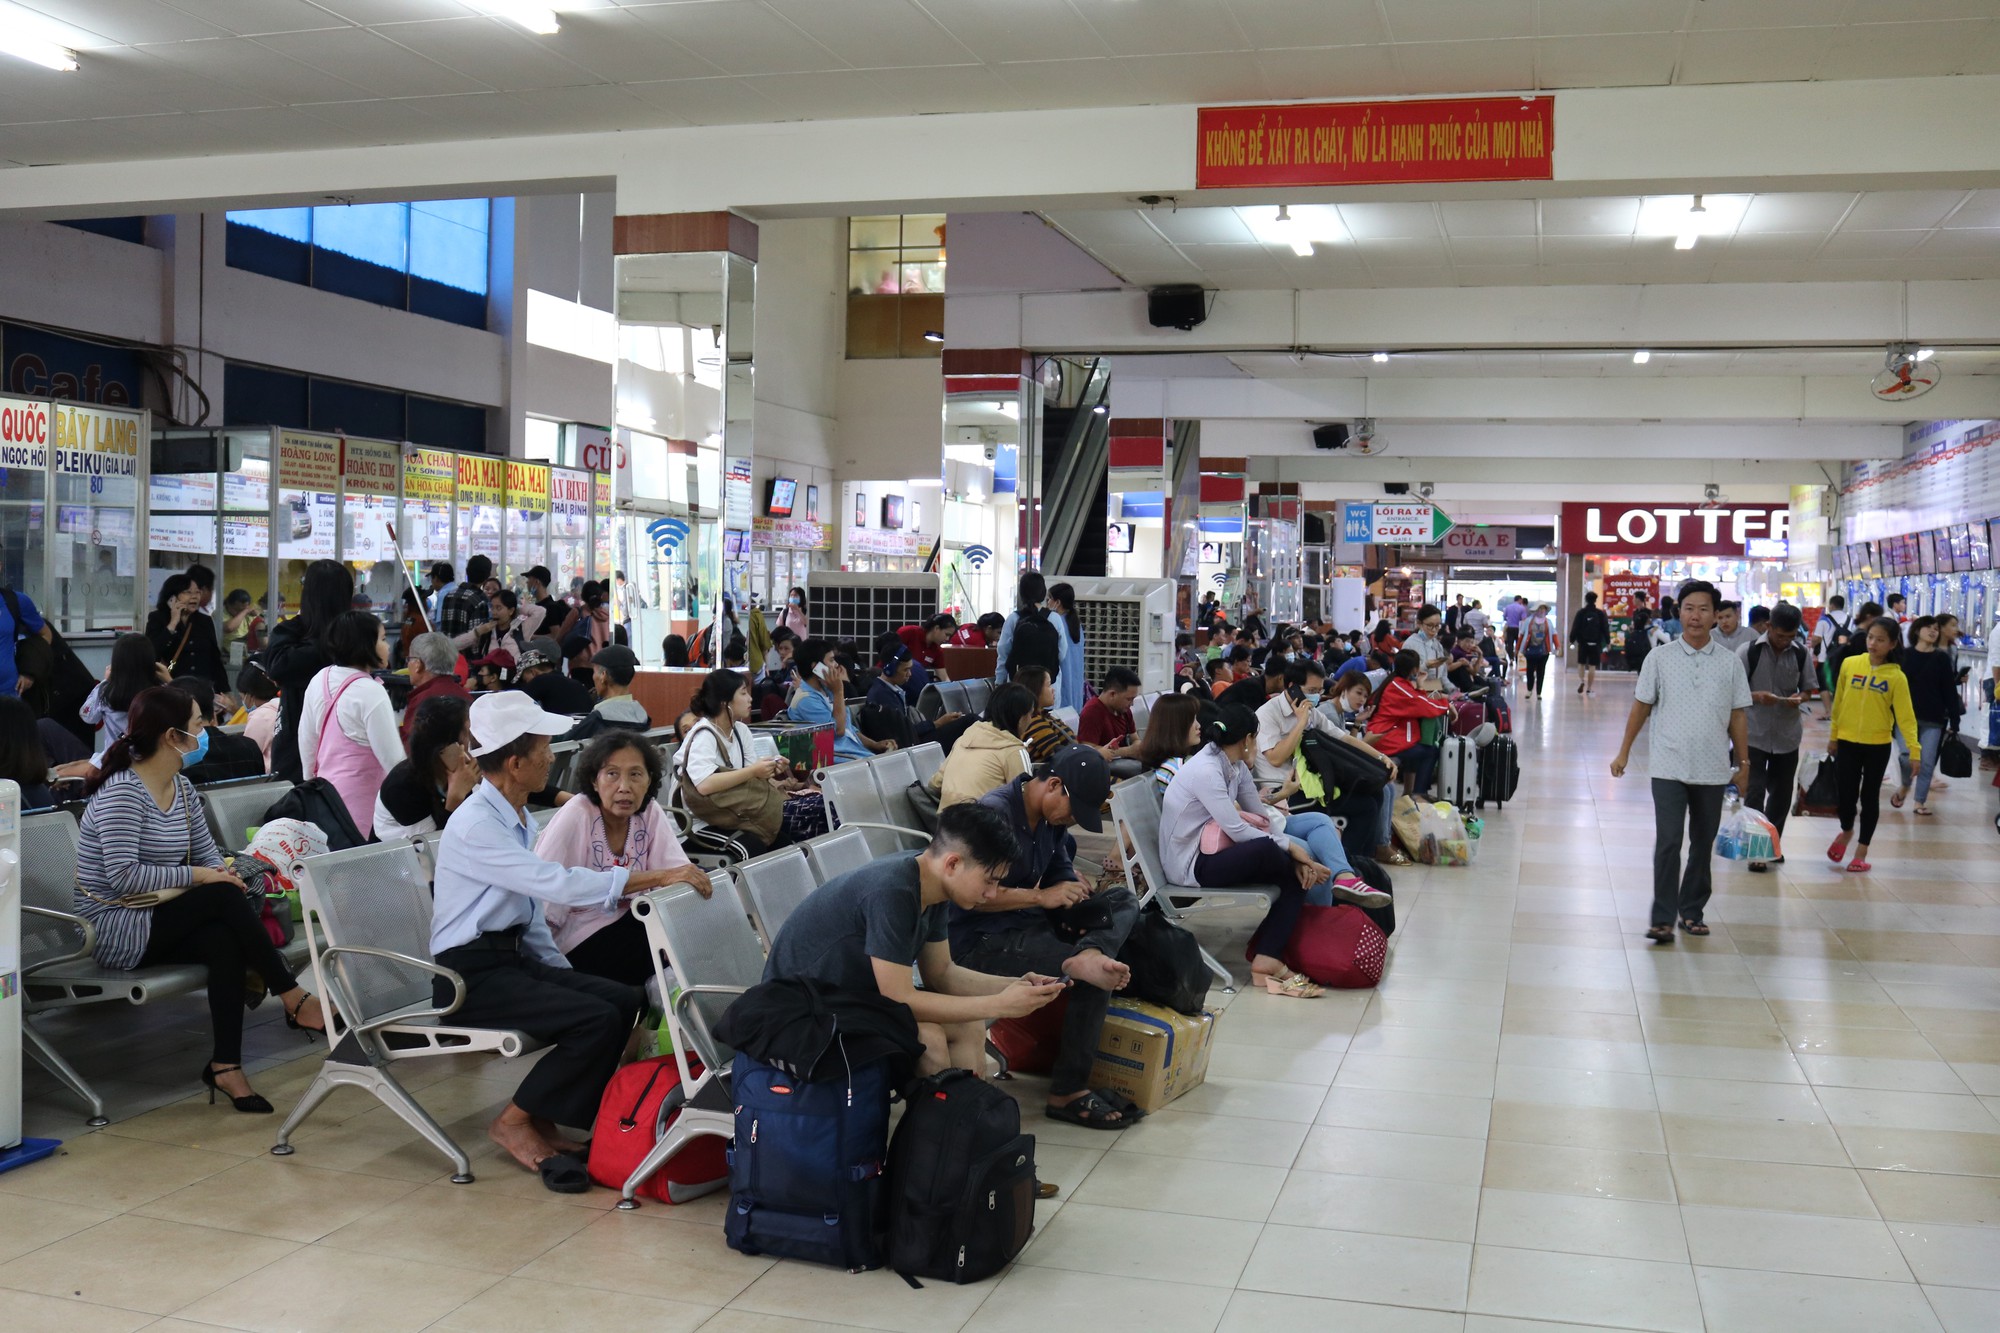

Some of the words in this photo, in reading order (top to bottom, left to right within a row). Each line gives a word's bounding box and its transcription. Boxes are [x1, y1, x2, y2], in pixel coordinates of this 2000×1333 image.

[1206, 122, 1246, 167] KHÔNG
[1248, 113, 1266, 166] ĐỂ
[1268, 115, 1292, 165] XẢY
[1294, 127, 1311, 165] RA
[1313, 118, 1347, 171] CHÁY,
[1352, 108, 1371, 163] NỔ
[1372, 116, 1387, 162] LÀ
[1391, 124, 1424, 169] HẠNH
[1429, 114, 1462, 161] PHÚC
[1465, 108, 1489, 161] CỦA
[1493, 120, 1516, 167] MỌI
[1519, 112, 1544, 159] NHÀ
[10, 352, 130, 408] Cafe
[1, 403, 46, 445] QUỐC
[56, 407, 91, 450] BẢY
[94, 416, 137, 456] LANG
[1, 446, 29, 468] NGỌC
[56, 450, 102, 475] PLEIKU
[103, 454, 119, 476] (GIA
[121, 457, 136, 478] LAI)
[280, 446, 311, 461] HOÀNG
[313, 451, 336, 463] LONG
[427, 452, 453, 469] CHÂU
[346, 457, 377, 476] HOÀNG
[379, 463, 395, 478] KIM
[420, 467, 436, 475] SƠN
[457, 457, 479, 487] HOA
[481, 461, 500, 489] MAI
[90, 475, 103, 494] 80
[506, 463, 526, 492] HOA
[528, 467, 546, 494] MAI
[301, 491, 310, 506] 81
[364, 494, 373, 509] 82
[1350, 509, 1367, 518] WC
[1376, 505, 1394, 516] LỐI
[1397, 508, 1412, 516] RA
[1377, 525, 1412, 536] CỬA
[1418, 527, 1428, 536] F
[1447, 528, 1489, 547] CỬA
[1496, 535, 1510, 547] E
[1851, 674, 1889, 693] FILA
